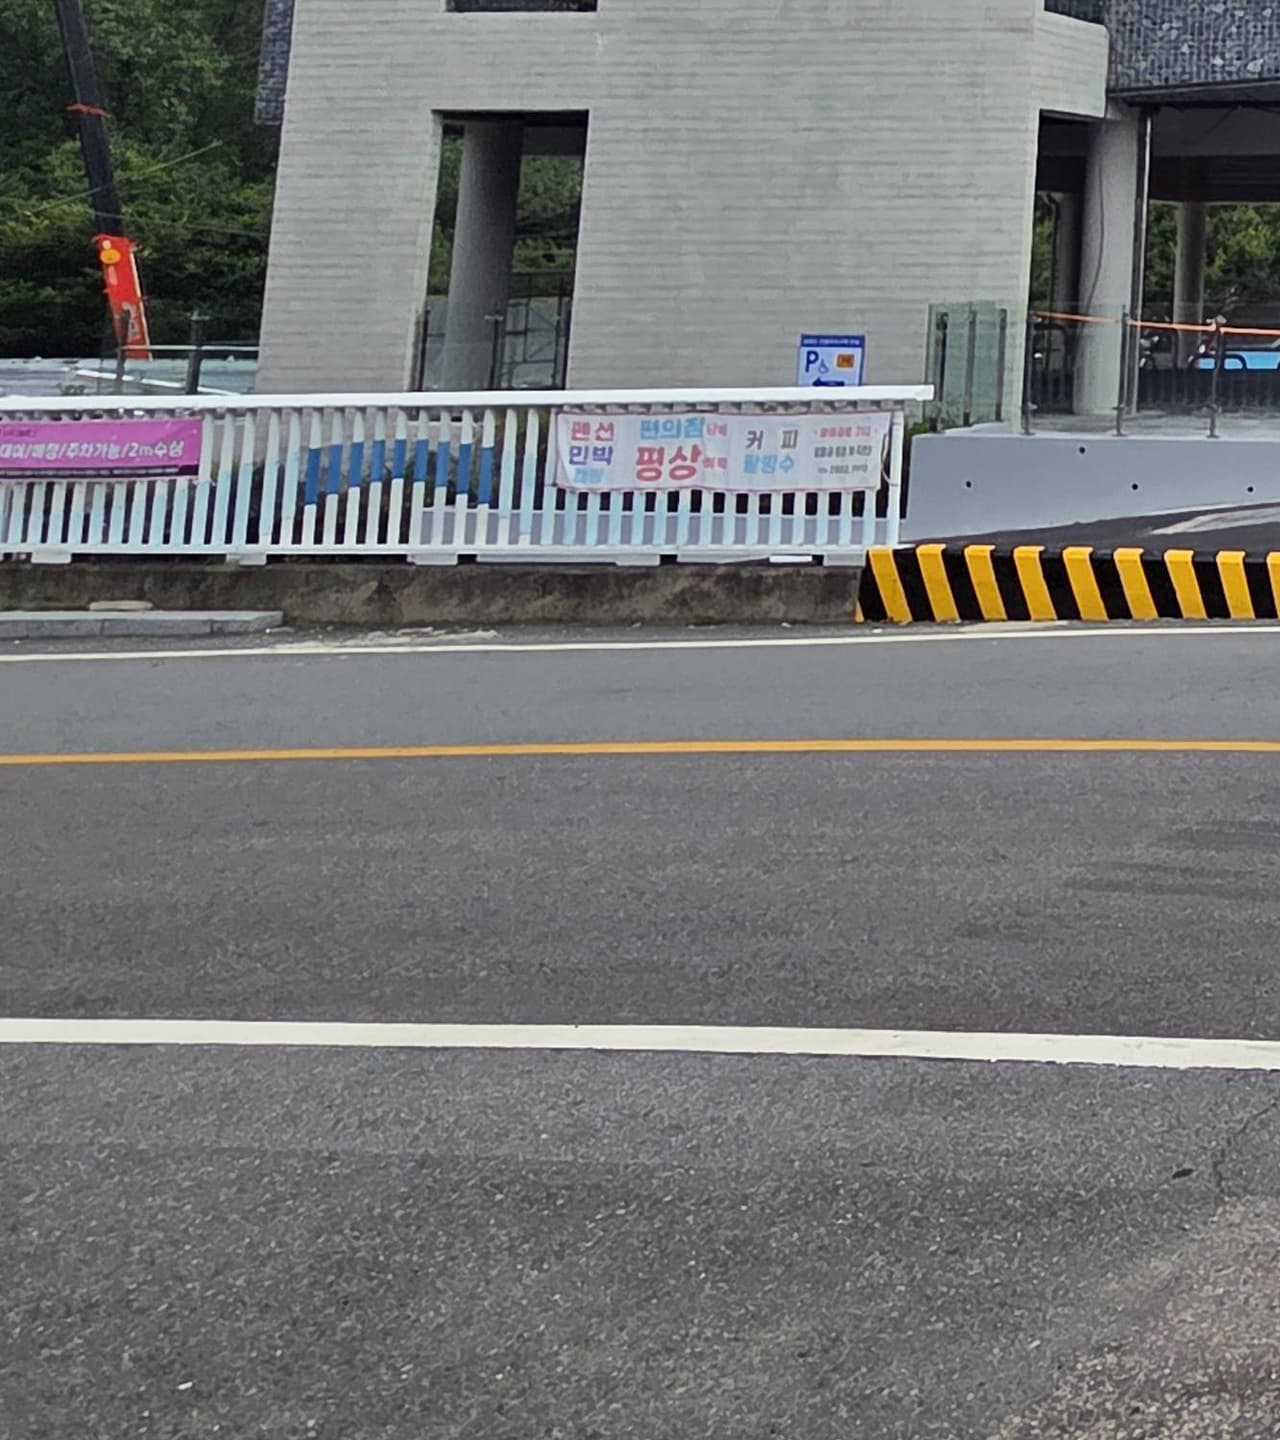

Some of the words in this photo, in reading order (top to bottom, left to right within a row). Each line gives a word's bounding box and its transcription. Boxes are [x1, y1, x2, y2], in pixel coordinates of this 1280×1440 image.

[805, 350, 819, 373] P
[569, 445, 614, 465] 민박
[635, 444, 702, 482] 평상
